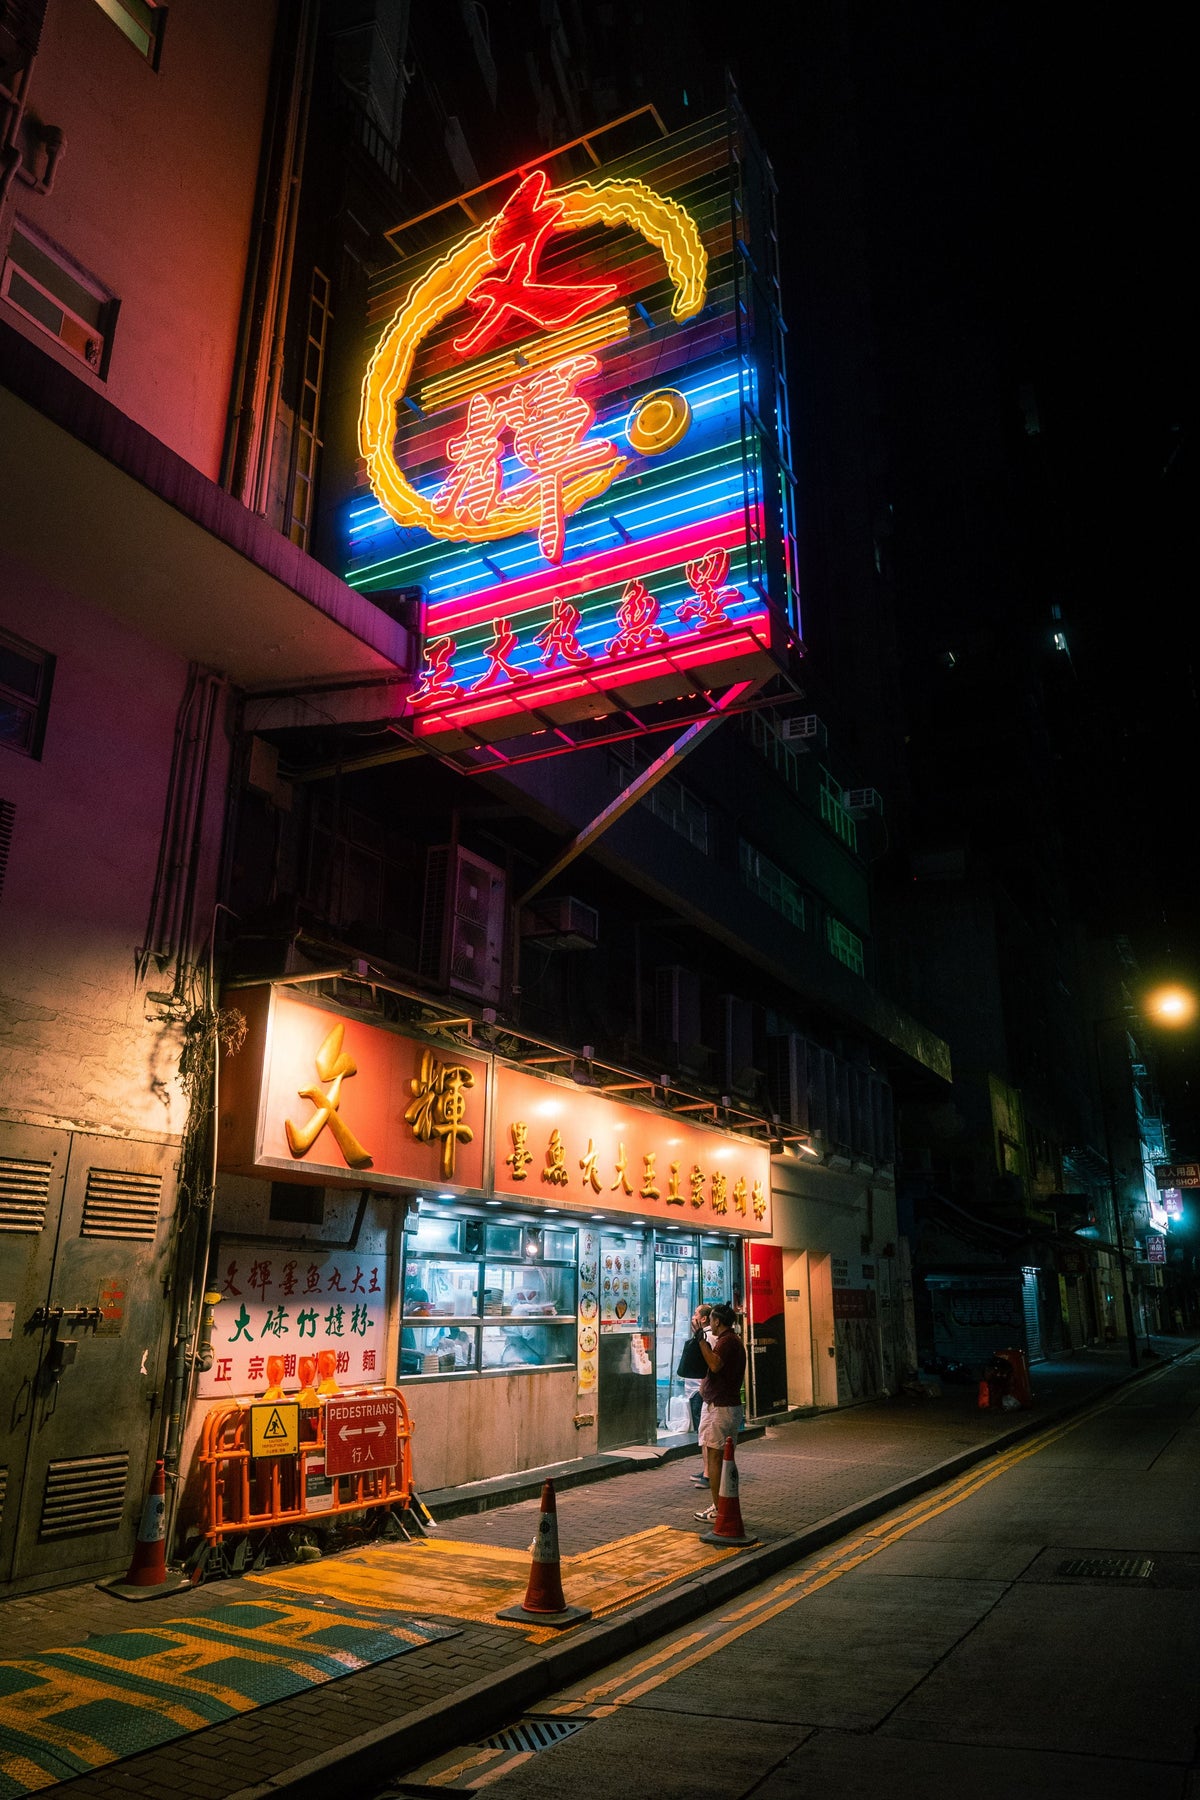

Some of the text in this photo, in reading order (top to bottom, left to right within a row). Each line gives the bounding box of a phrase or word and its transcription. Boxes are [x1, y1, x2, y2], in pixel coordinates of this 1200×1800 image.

[285, 1022, 476, 1179] 文輝
[1175, 1178, 1199, 1186] SHOP
[221, 1260, 382, 1302] 文輝墨魚丸大王
[329, 1402, 395, 1421] PEDESTRIANS
[351, 1444, 375, 1464] 行人
